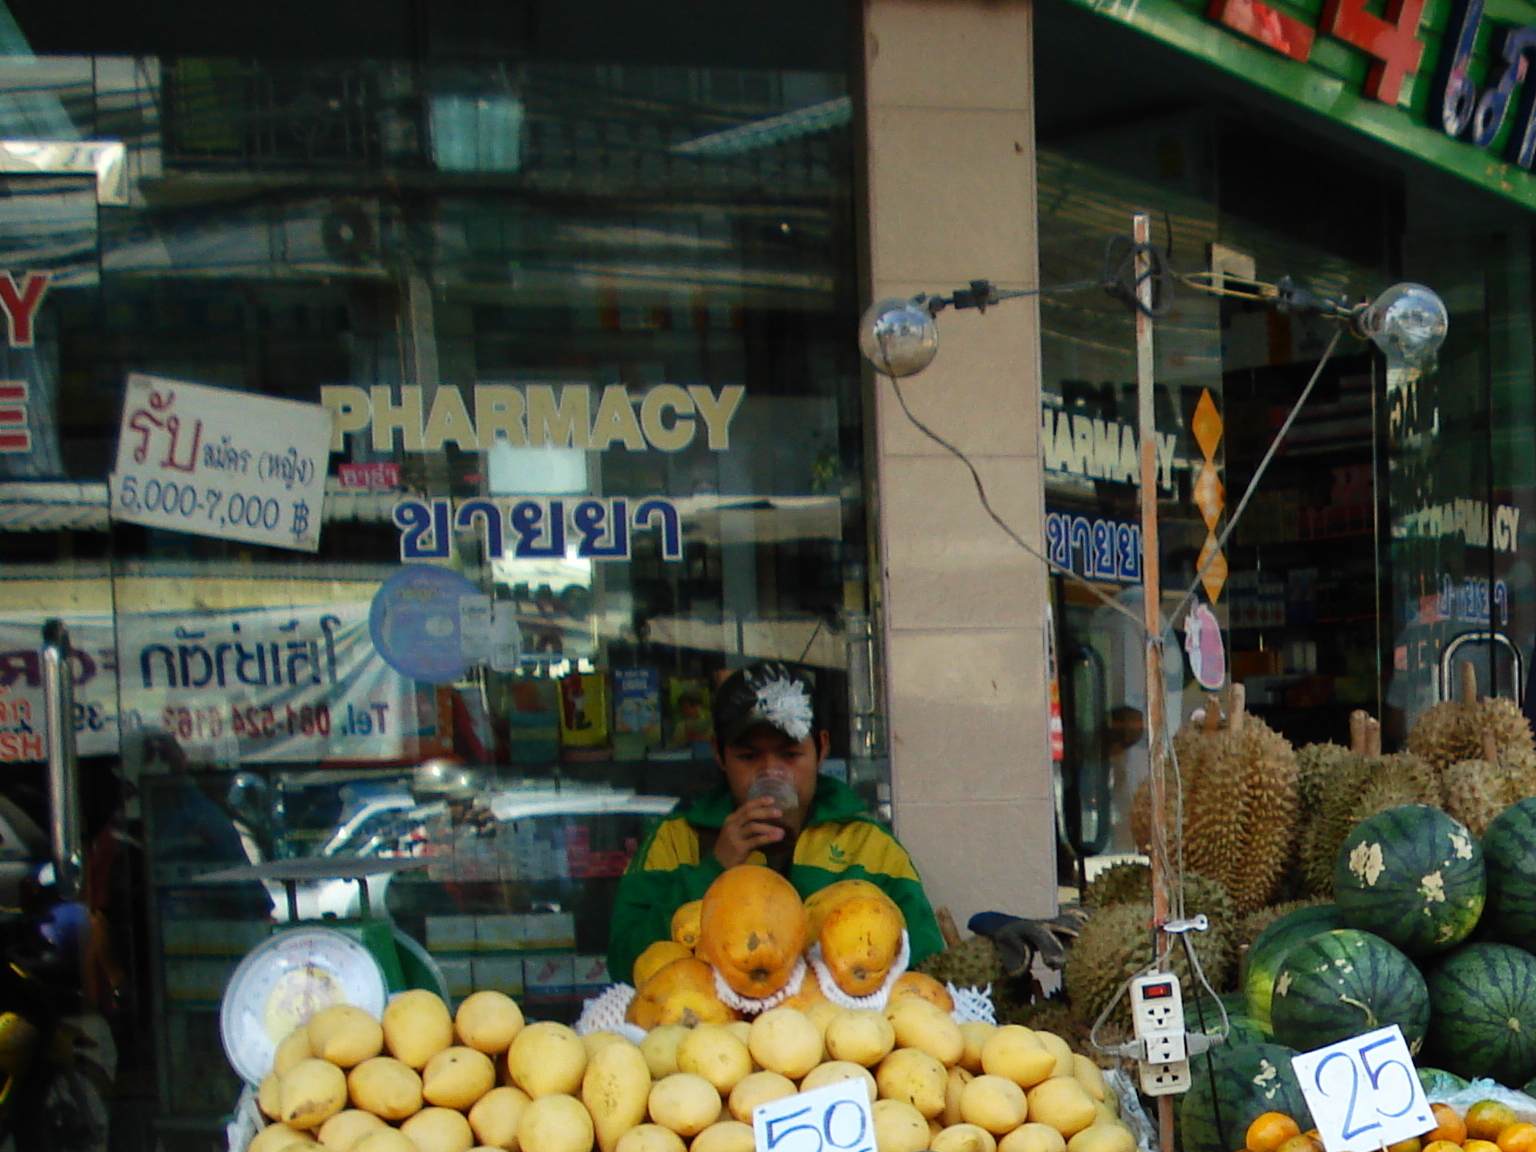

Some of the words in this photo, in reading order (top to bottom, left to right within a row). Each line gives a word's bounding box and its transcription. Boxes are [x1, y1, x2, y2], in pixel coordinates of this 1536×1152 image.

[128, 391, 206, 474] รับ
[320, 384, 746, 452] PHARMACY
[1042, 408, 1177, 490] HARMAY
[392, 497, 684, 562] ขายยา
[1046, 513, 1144, 582] ขายย
